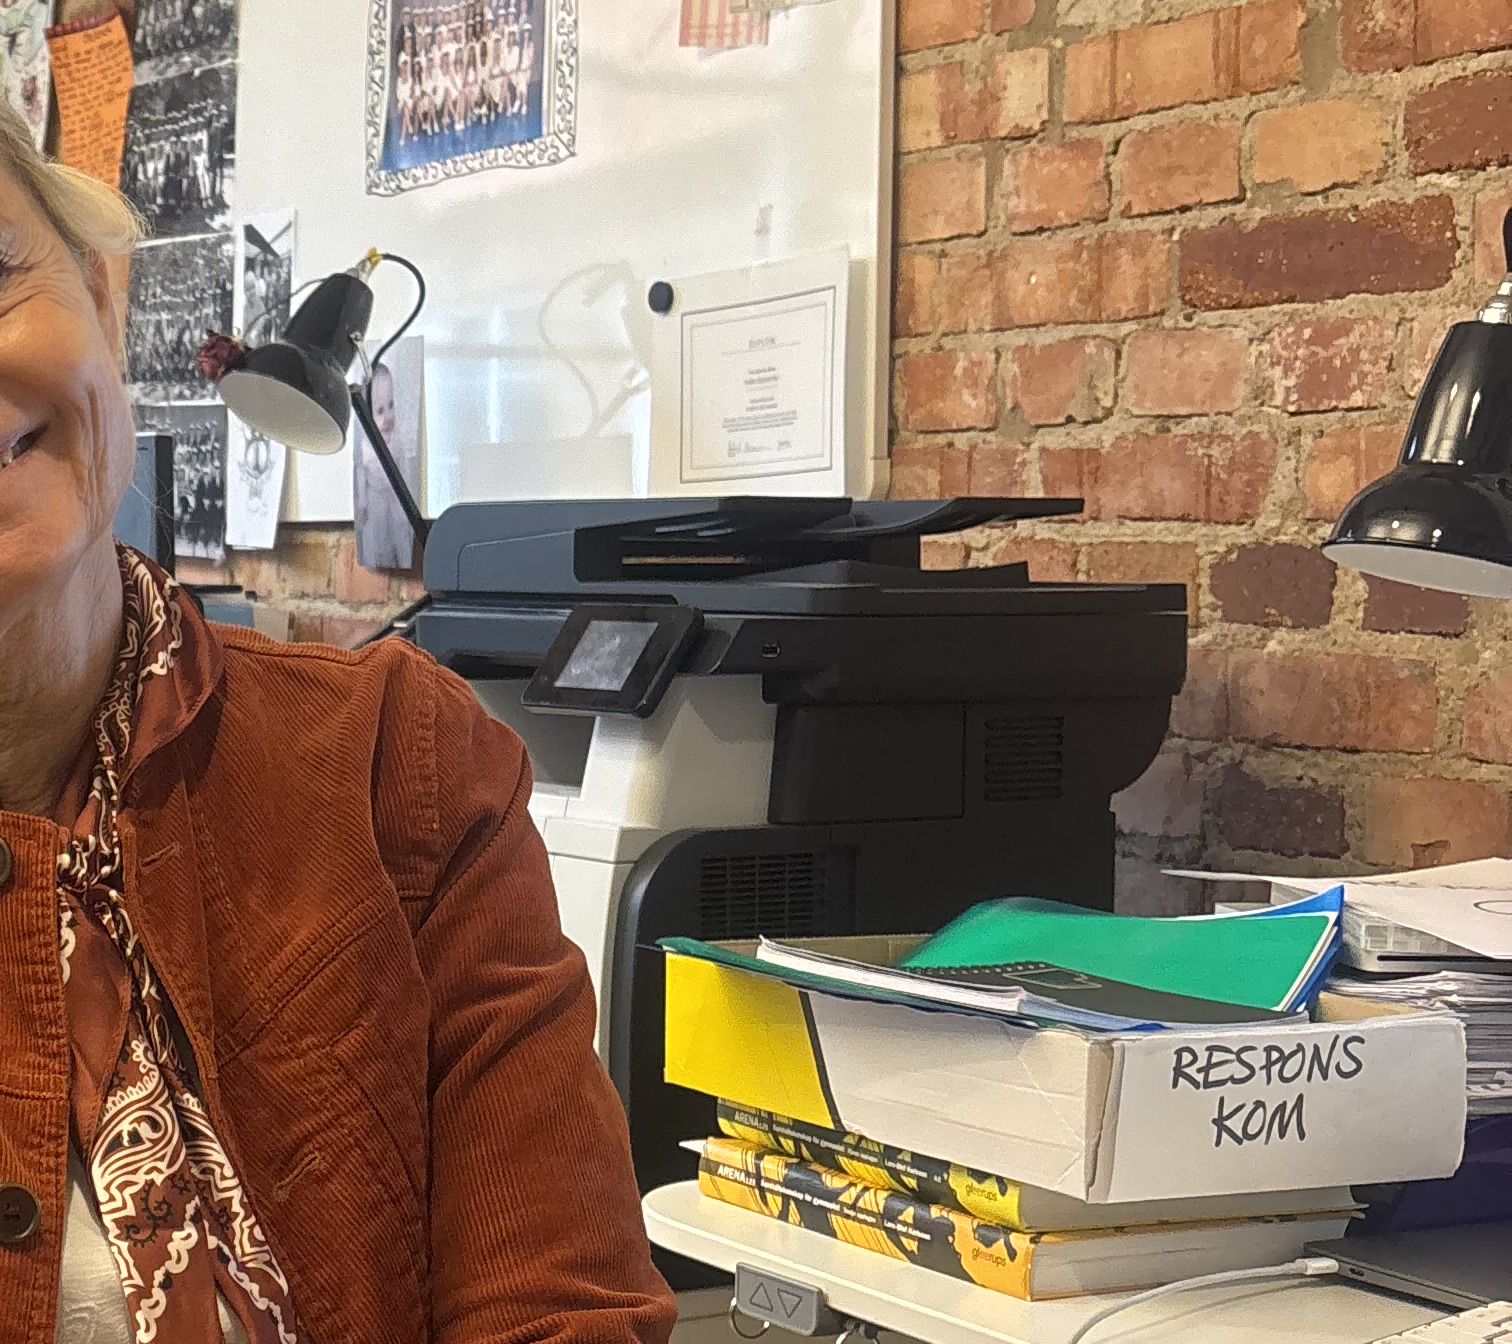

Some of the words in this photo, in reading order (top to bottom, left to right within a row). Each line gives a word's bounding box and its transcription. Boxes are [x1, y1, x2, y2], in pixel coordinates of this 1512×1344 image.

[1171, 1034, 1366, 1090] RESPONS
[1211, 1093, 1306, 1148] KOM
[972, 1246, 1007, 1267] gleerups
